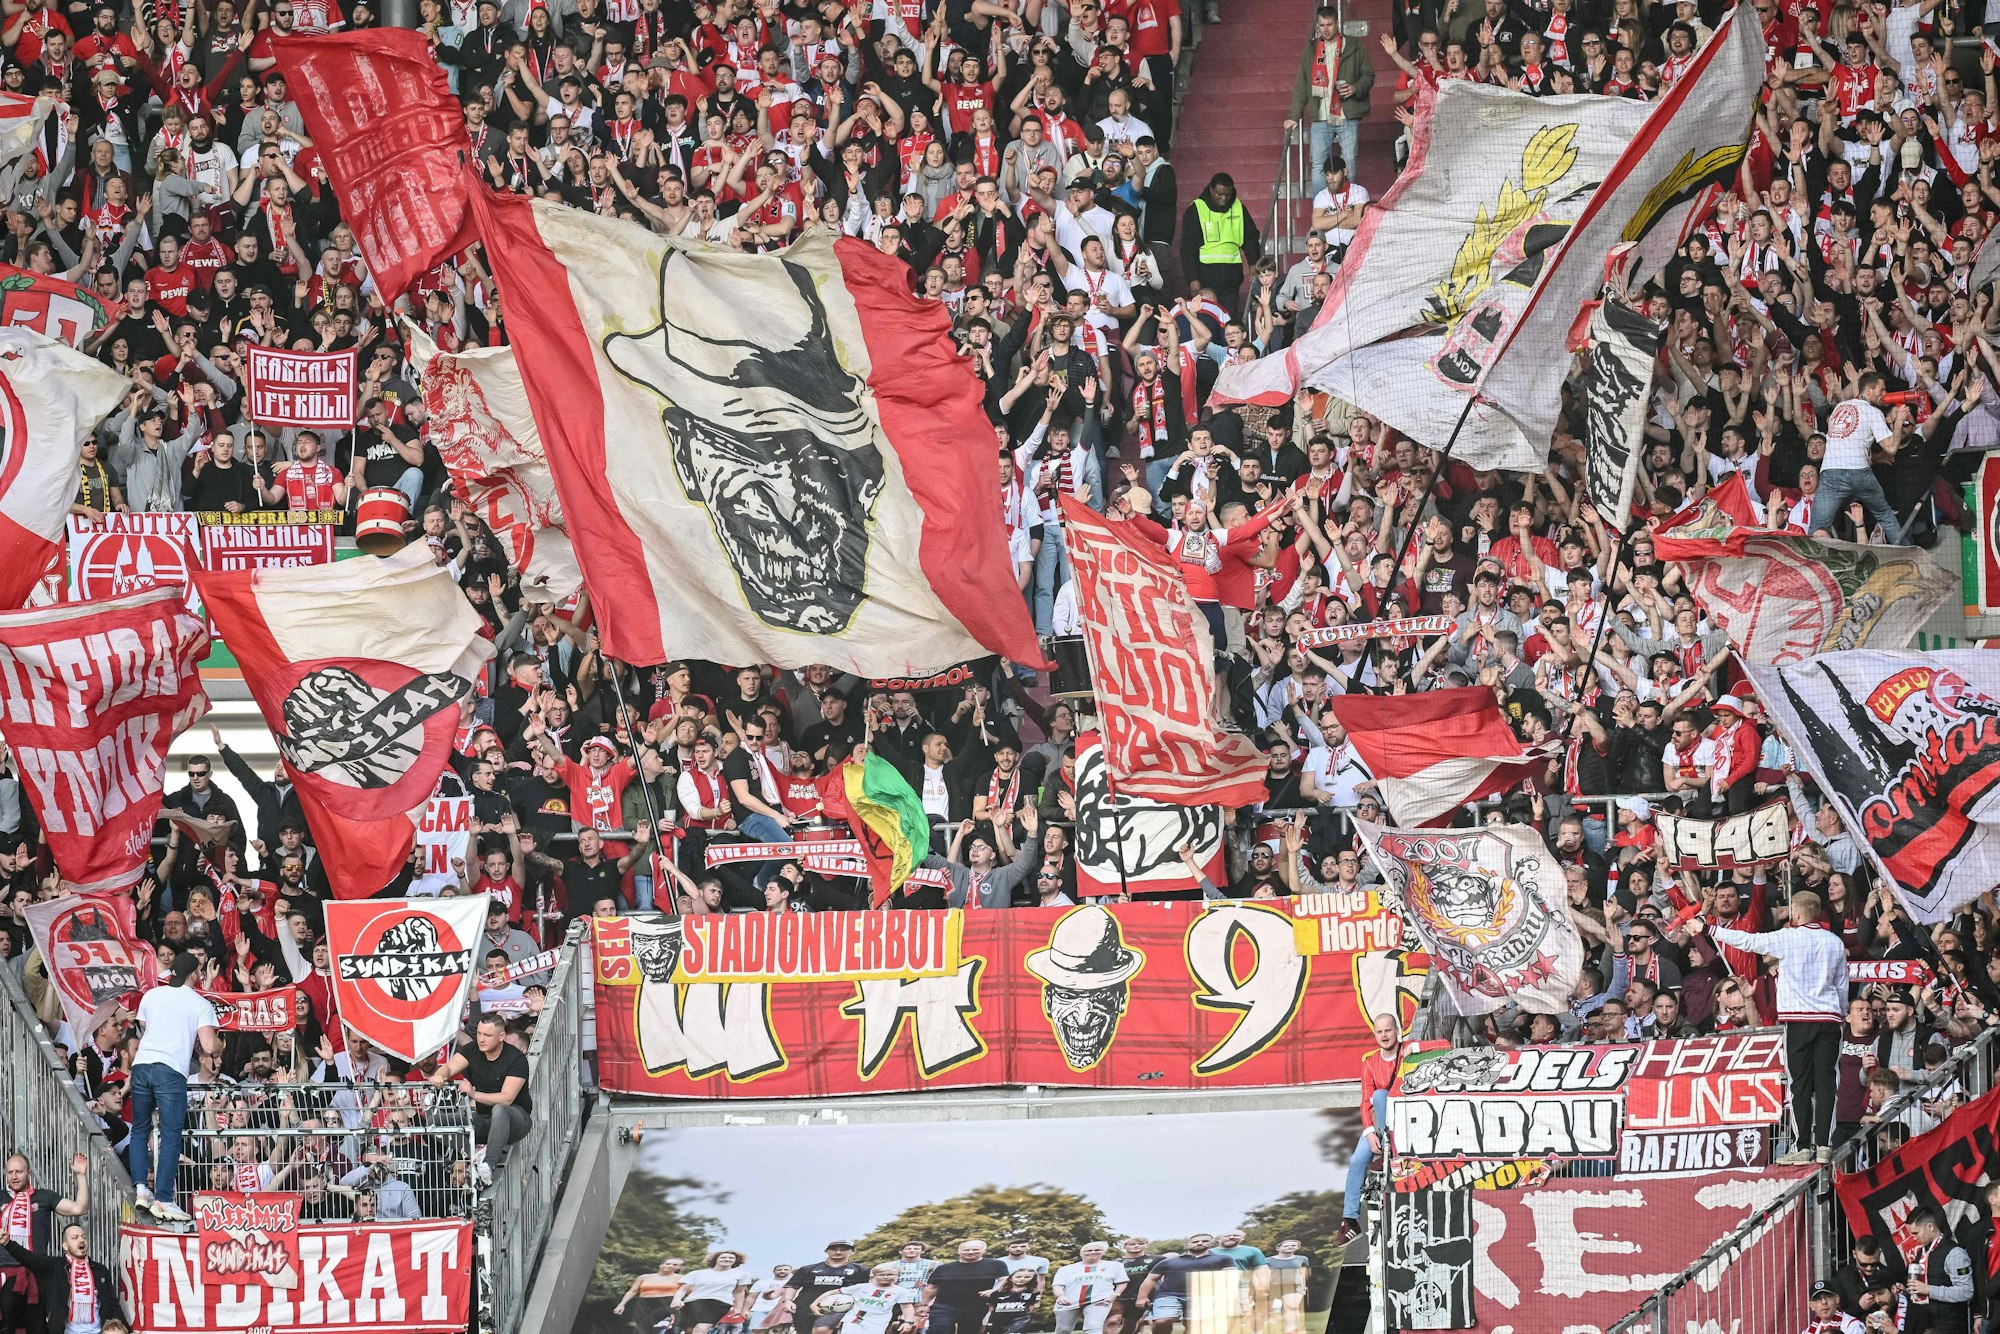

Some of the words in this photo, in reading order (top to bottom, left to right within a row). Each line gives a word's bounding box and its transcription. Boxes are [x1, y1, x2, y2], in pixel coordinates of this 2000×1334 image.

[957, 99, 984, 110] REWE
[161, 287, 188, 300] REWE
[255, 356, 348, 383] RASCALS
[294, 392, 347, 418] KÖLN
[74, 513, 192, 534] CHAOTIX
[222, 511, 318, 525] DESPERADOS
[1301, 624, 1368, 647] FIGHT
[1395, 614, 1450, 634] CLUB
[871, 664, 974, 691] CONTROL
[1656, 801, 1790, 867] 1948
[708, 847, 773, 861] WILDE
[1397, 835, 1482, 863] 2007
[807, 855, 868, 873] WILDE
[1294, 891, 1365, 916] Junge
[601, 916, 631, 980] SEK
[683, 910, 950, 975] STADIONVERBOT
[1321, 917, 1401, 953] Horde
[237, 996, 287, 1027] RAS
[1629, 1072, 1783, 1126] JUNGS
[1394, 1099, 1618, 1157] RADAU
[1621, 1131, 1732, 1173] RAFIKIS
[813, 1275, 845, 1285] WWK
[856, 1297, 887, 1309] WWK
[996, 1302, 1026, 1311] WWK
